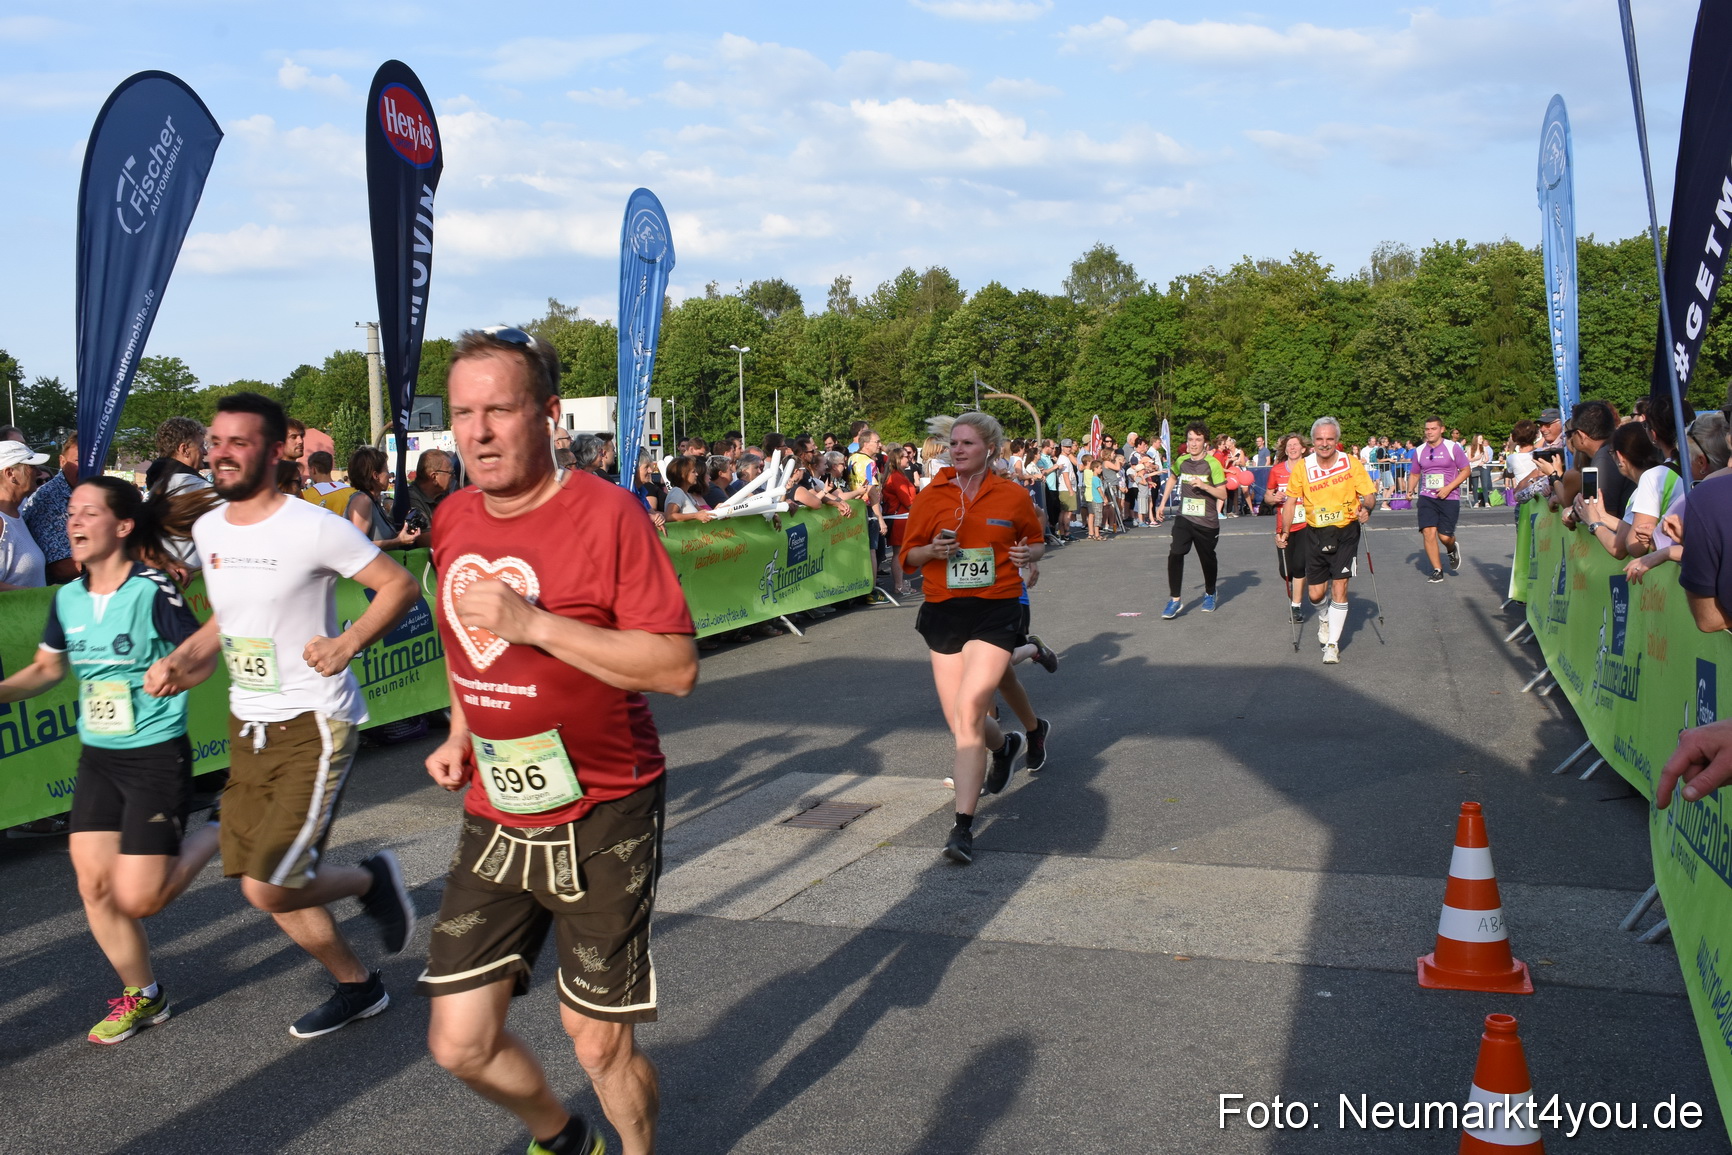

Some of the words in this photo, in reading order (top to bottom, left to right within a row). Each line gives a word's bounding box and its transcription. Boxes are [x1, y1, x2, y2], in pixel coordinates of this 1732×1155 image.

[384, 95, 433, 151] Hervis
[130, 115, 177, 217] Fischer
[150, 135, 184, 216] AUTOMOBILE
[1309, 481, 1330, 493] MAX
[1331, 472, 1353, 485] BÖGL
[1186, 503, 1200, 512] 301
[1318, 511, 1341, 522] 1537
[777, 548, 825, 590] firmenlauf
[951, 561, 989, 578] 1794
[779, 583, 801, 599] neumarkt
[368, 669, 421, 701] neumarkt
[463, 694, 480, 706] mit
[480, 695, 511, 710] Herz
[491, 764, 546, 793] 696
